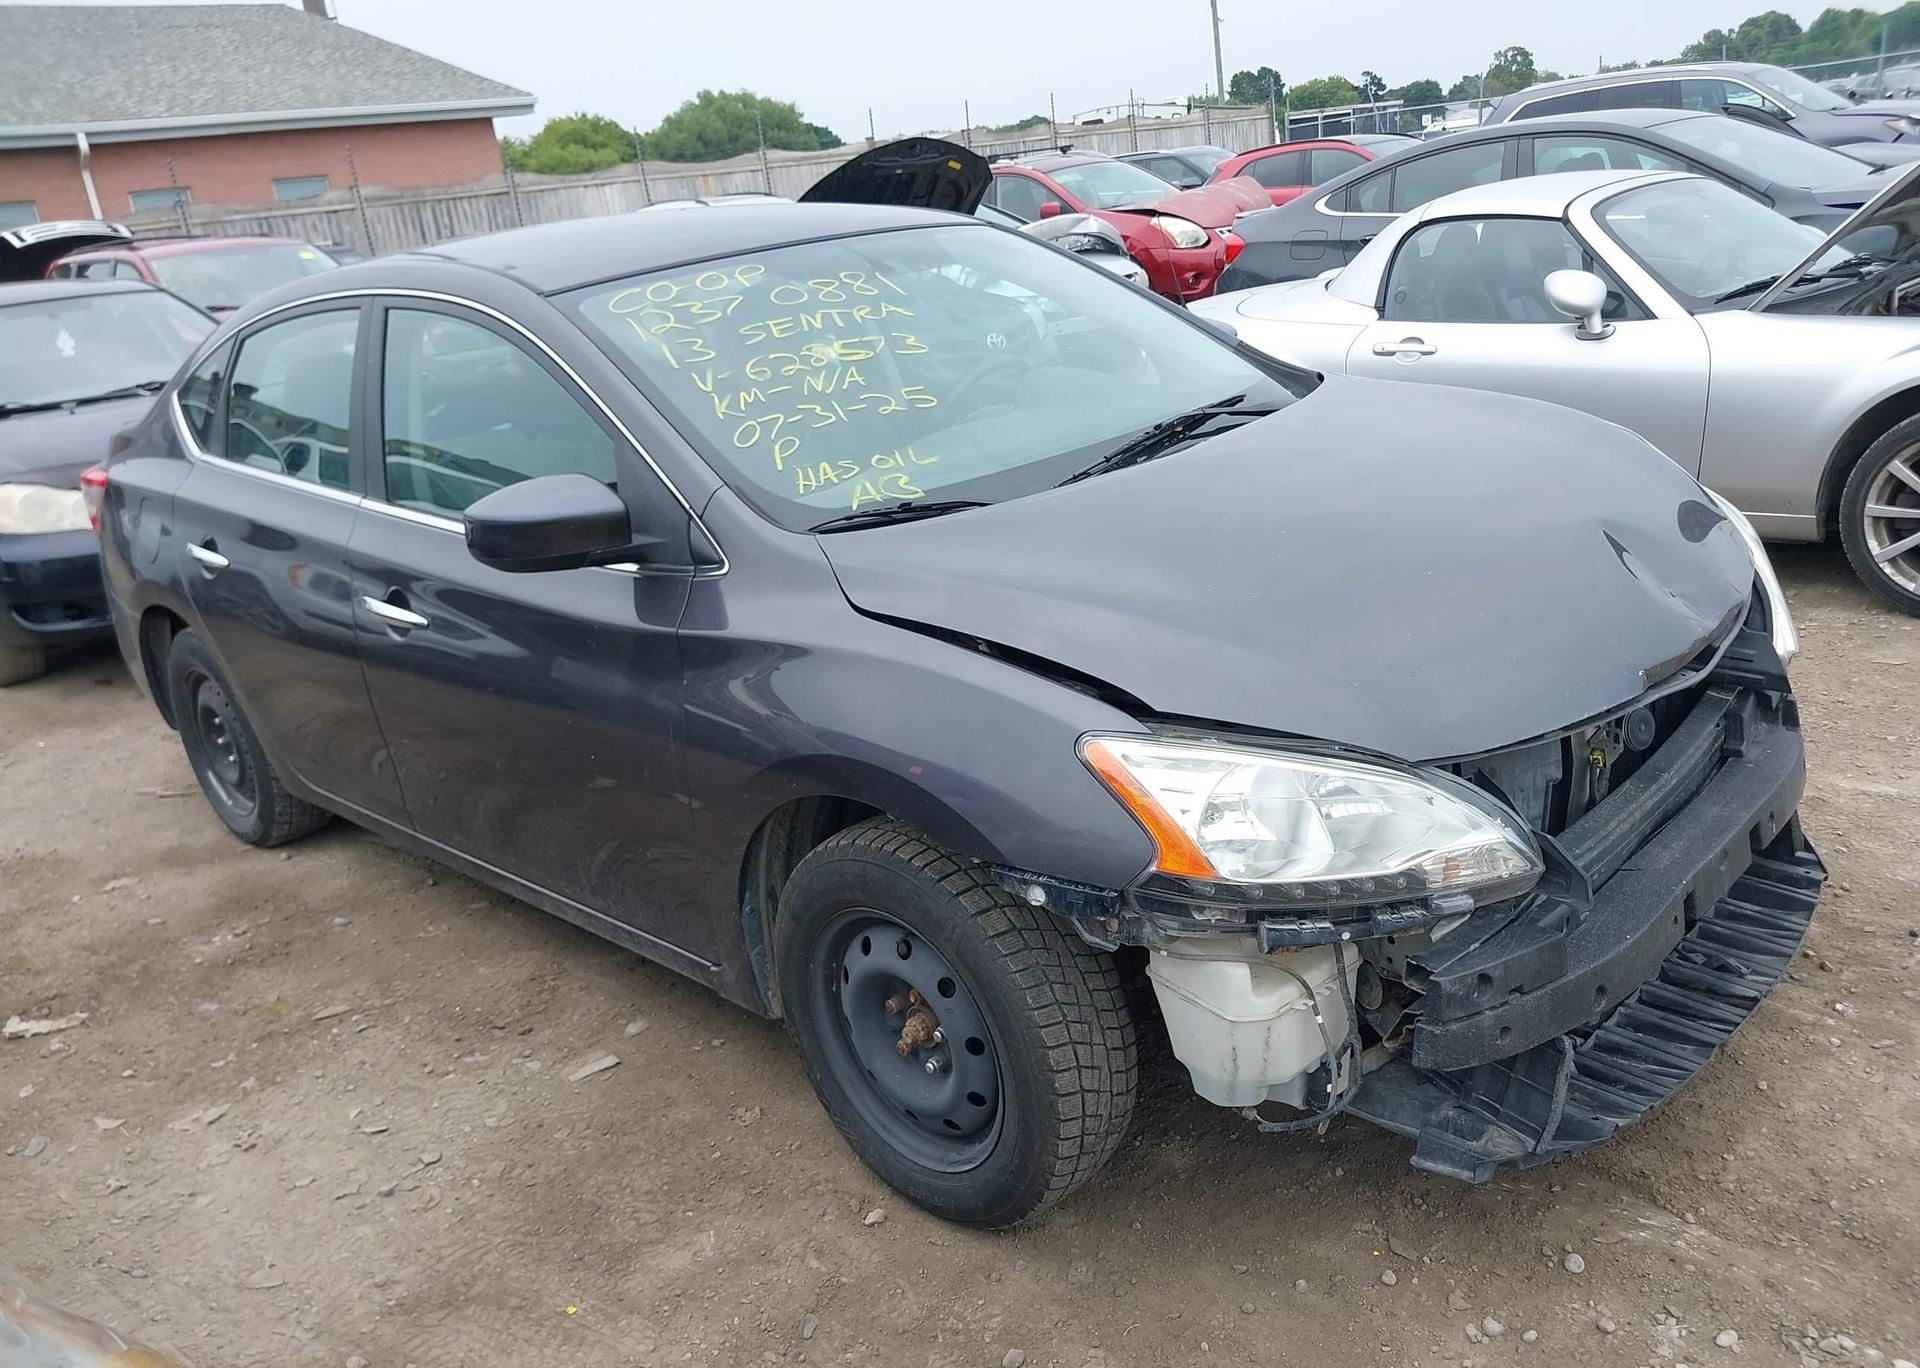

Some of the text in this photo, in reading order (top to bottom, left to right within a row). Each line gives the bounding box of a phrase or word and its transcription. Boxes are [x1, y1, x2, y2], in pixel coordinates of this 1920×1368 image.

[608, 264, 766, 314] CO-OP
[626, 271, 908, 343] 1237 0881
[660, 301, 917, 369] 13 SENTRA
[733, 386, 938, 448] 07-31-25
[773, 436, 800, 471] P
[795, 447, 939, 495] HAS OIL
